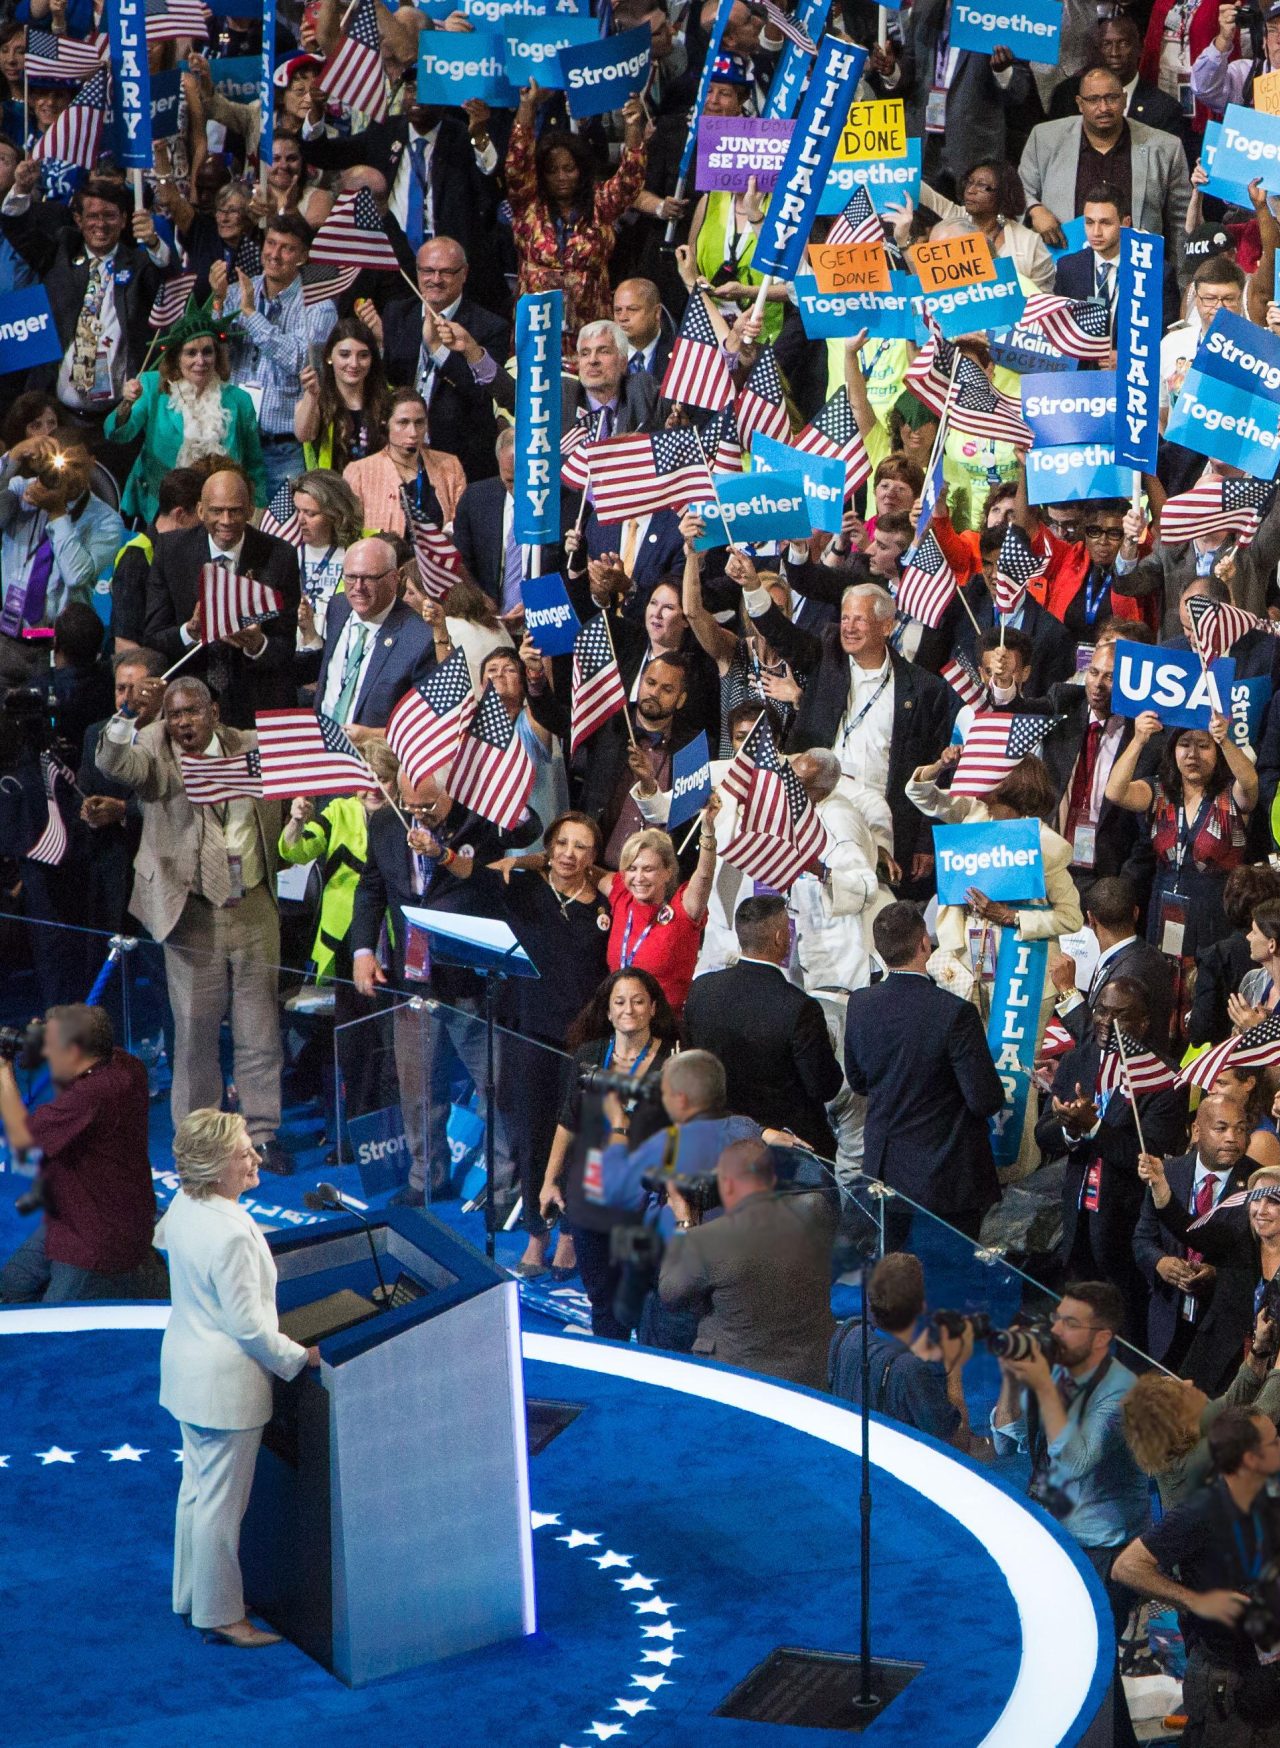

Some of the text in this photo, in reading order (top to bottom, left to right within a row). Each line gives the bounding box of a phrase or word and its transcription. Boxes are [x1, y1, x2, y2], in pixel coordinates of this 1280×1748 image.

[956, 5, 1057, 37] Together
[568, 48, 650, 89] Stronger
[1259, 76, 1280, 94] GET
[881, 103, 902, 125] IT
[716, 137, 791, 154] JUNTOS
[774, 48, 855, 250] HILLARY
[844, 130, 903, 155] DONE
[708, 154, 790, 171] SE PUED
[820, 246, 882, 270] GET IT
[916, 238, 976, 265] GET IT
[1184, 240, 1210, 255] LACK
[832, 271, 880, 287] DONE
[931, 257, 986, 284] DONE
[801, 291, 907, 317] Together
[911, 278, 1018, 314] Together
[1126, 241, 1153, 444] HILLARY
[528, 303, 552, 517] HILLARY
[694, 496, 803, 524] Together
[525, 604, 572, 630] Stronger
[1119, 656, 1222, 716] USA
[940, 845, 1038, 876] Together
[987, 930, 1030, 1137] ILLARY
